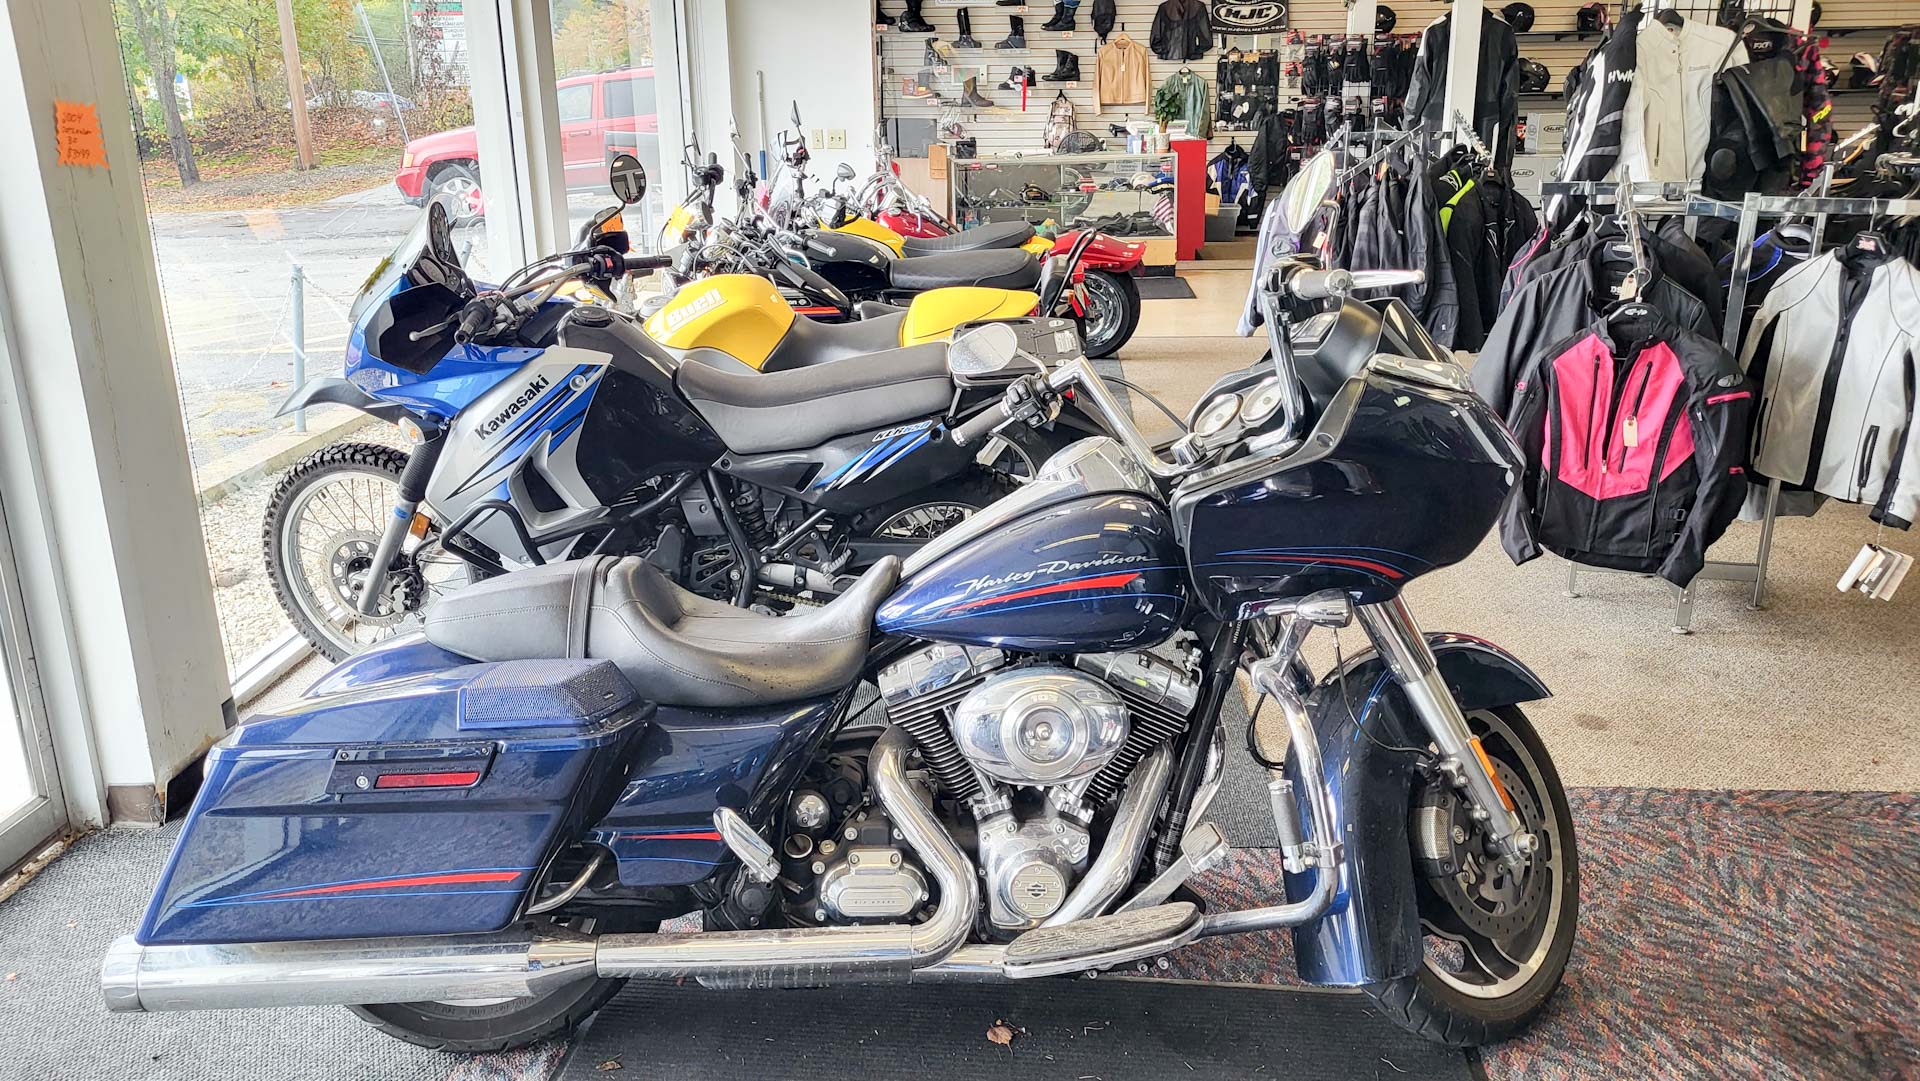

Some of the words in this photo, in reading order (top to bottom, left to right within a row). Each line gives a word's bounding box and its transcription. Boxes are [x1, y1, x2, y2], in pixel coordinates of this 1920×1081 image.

[1224, 6, 1273, 20] HJC
[665, 288, 725, 329] Buell
[474, 374, 550, 441] Kawasaki
[954, 554, 1159, 596] Harley-Davidson
